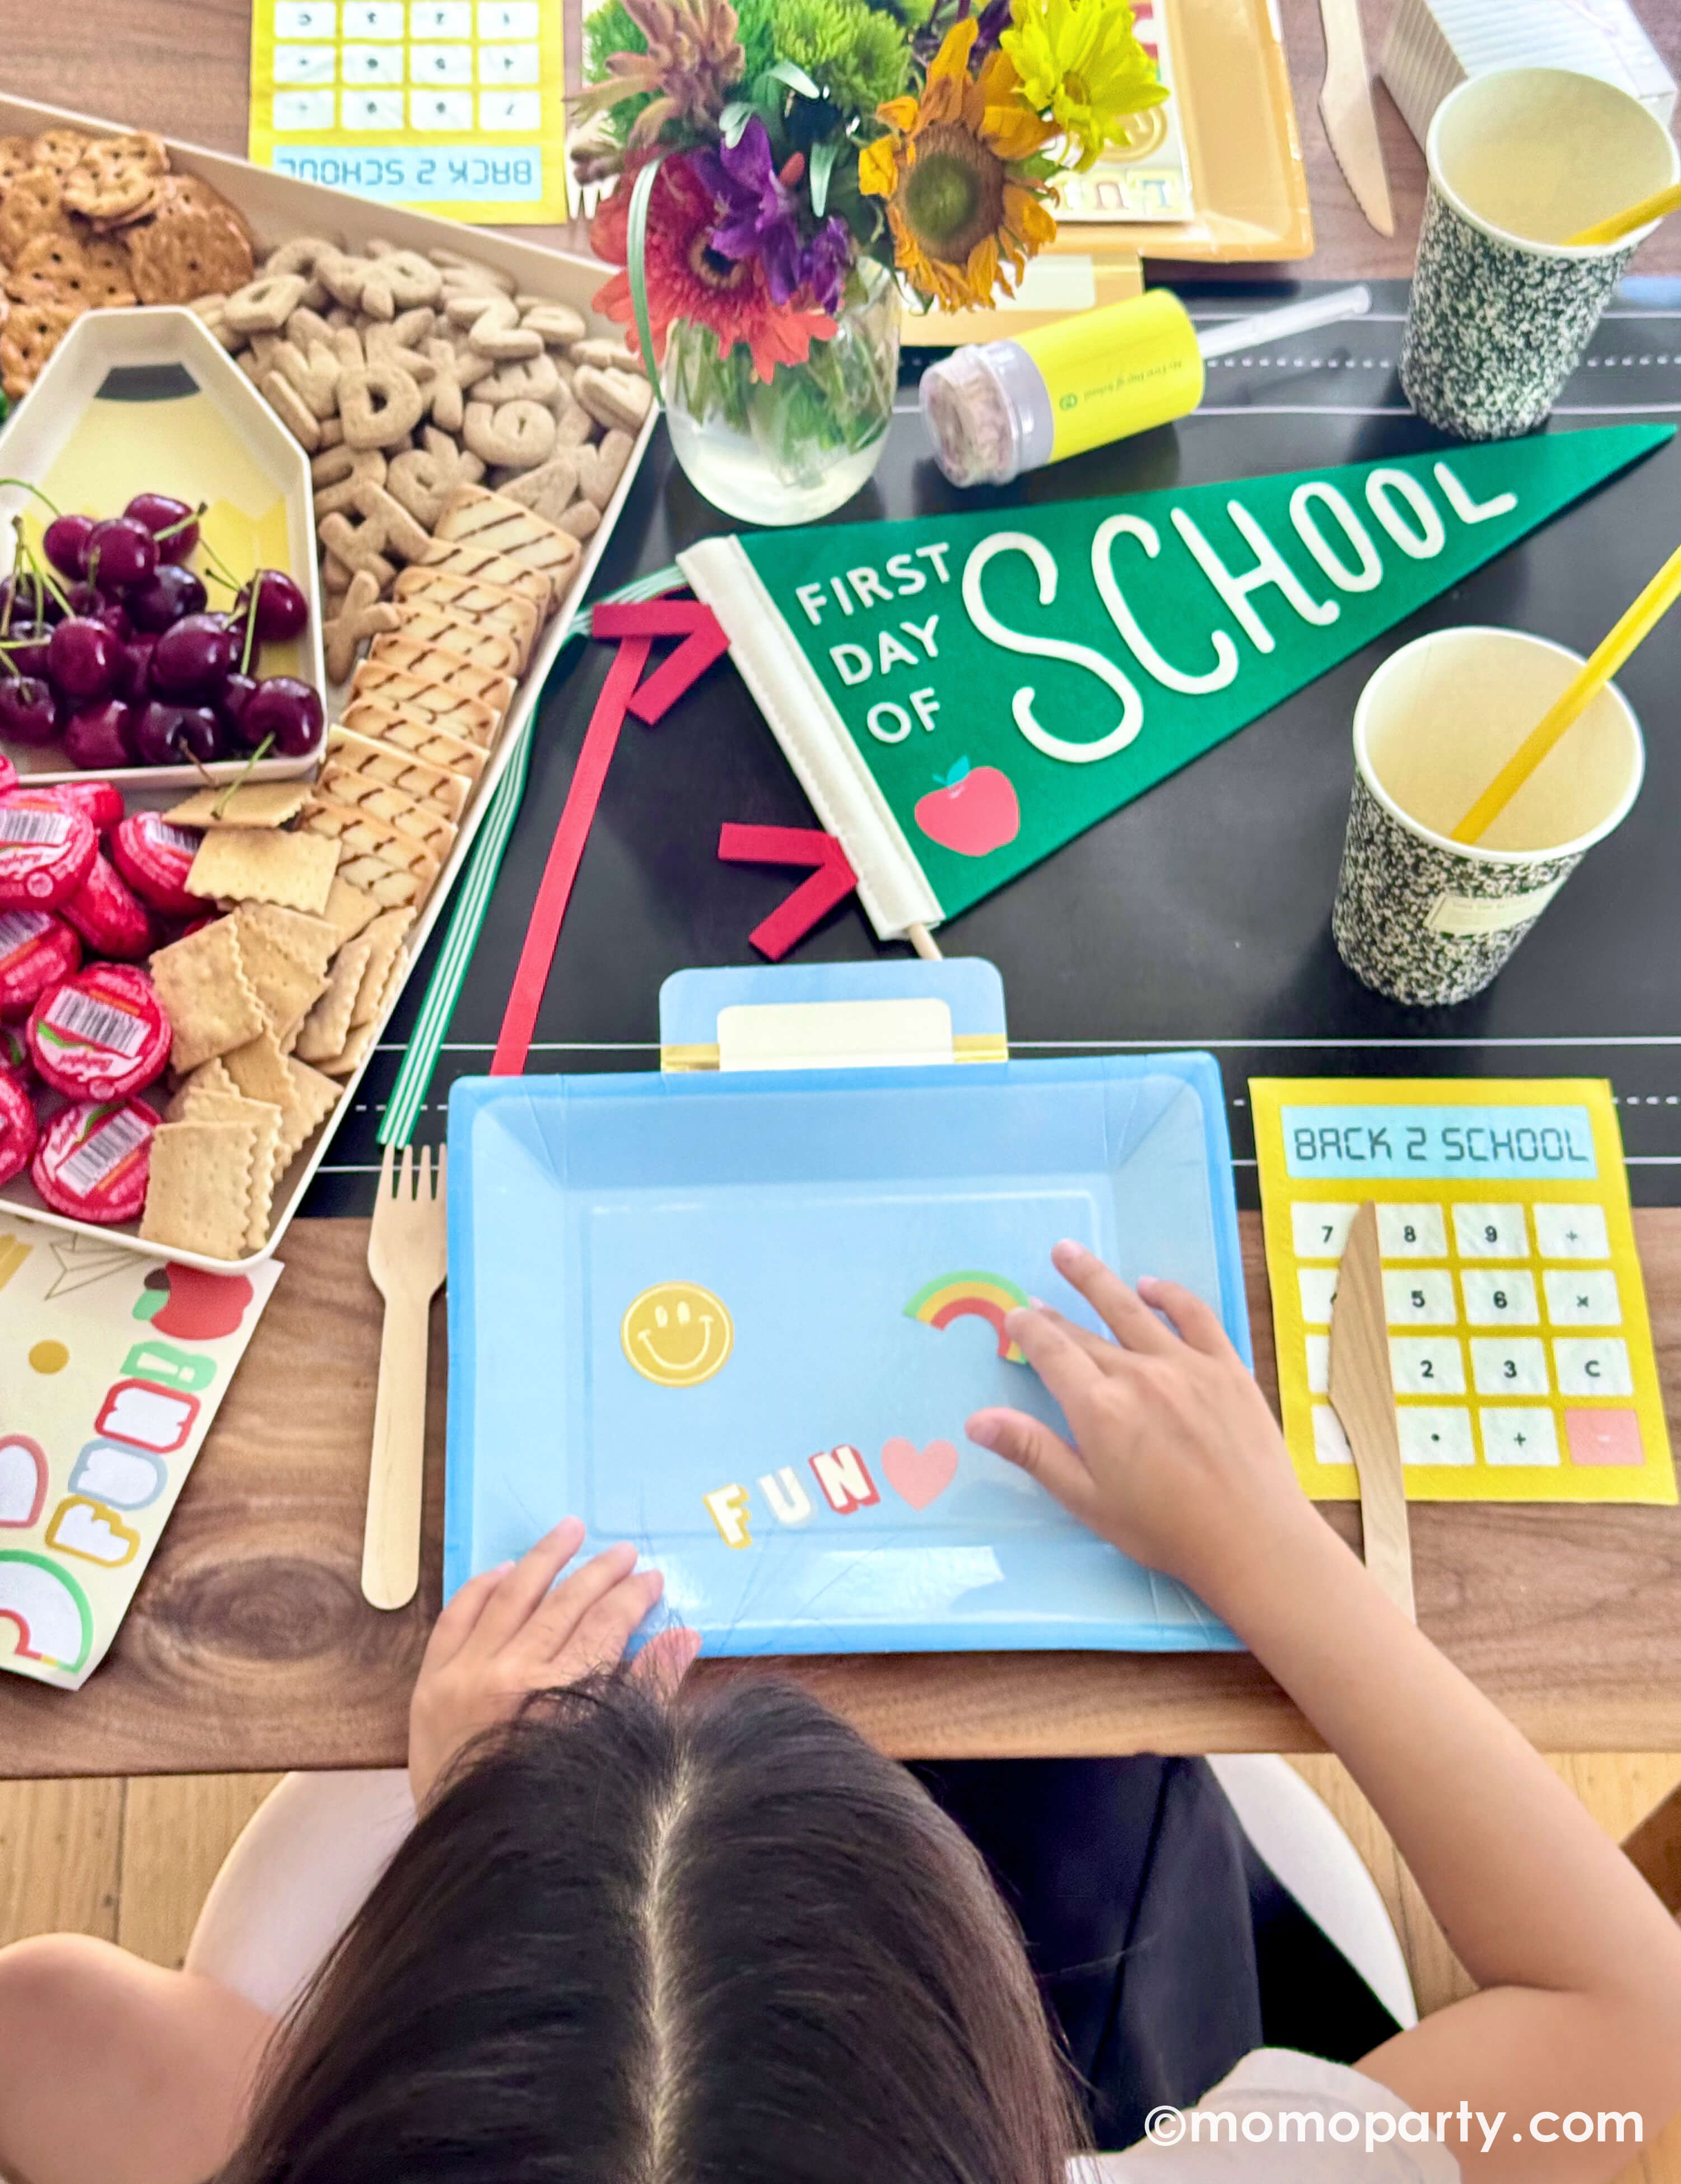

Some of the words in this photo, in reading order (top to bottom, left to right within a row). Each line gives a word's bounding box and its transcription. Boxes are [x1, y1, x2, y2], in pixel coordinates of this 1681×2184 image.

[416, 158, 437, 185] 2
[448, 159, 532, 185] BACK
[795, 542, 950, 626] FIRST
[961, 461, 1518, 763] SCHOOL
[829, 614, 940, 686] DAY
[867, 687, 941, 744] OF
[1294, 1127, 1393, 1161] BACK
[1406, 1127, 1428, 1161] 2
[1441, 1127, 1589, 1163] SCHOOL
[1322, 1225, 1334, 1243] 7
[1404, 1225, 1417, 1243] 8
[1484, 1225, 1498, 1243] 9
[1410, 1290, 1426, 1309] 5
[1493, 1290, 1508, 1309] 6
[1421, 1359, 1434, 1378] 2
[1503, 1360, 1517, 1379] 3
[1584, 1360, 1601, 1378] C
[702, 1444, 881, 1550] FUN
